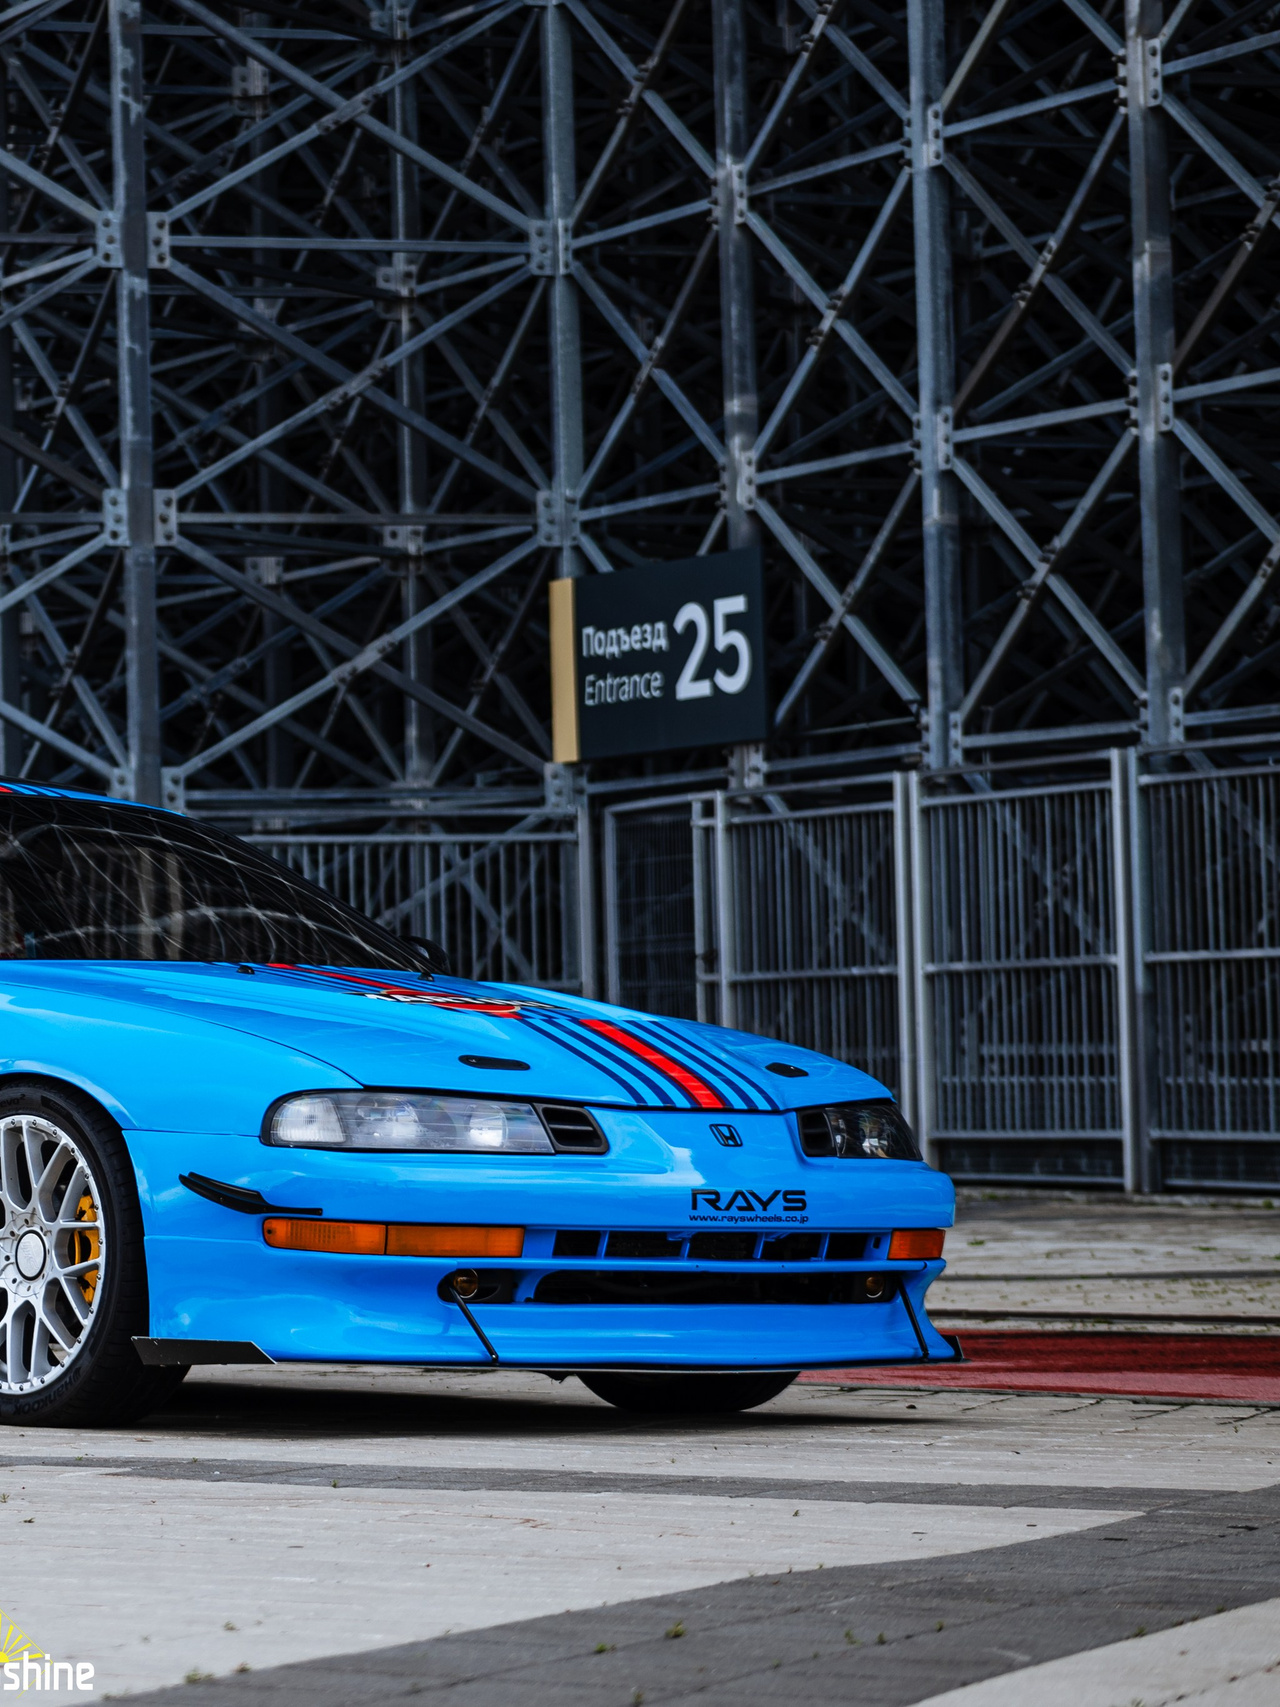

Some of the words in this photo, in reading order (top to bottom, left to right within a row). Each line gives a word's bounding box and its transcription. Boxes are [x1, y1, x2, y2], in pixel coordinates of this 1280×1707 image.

[582, 621, 669, 658] Подъезд
[674, 595, 751, 700] 25
[584, 672, 663, 705] Entrance
[691, 1188, 807, 1211] RAYS
[689, 1214, 809, 1224] www.rayswheels.co.jp
